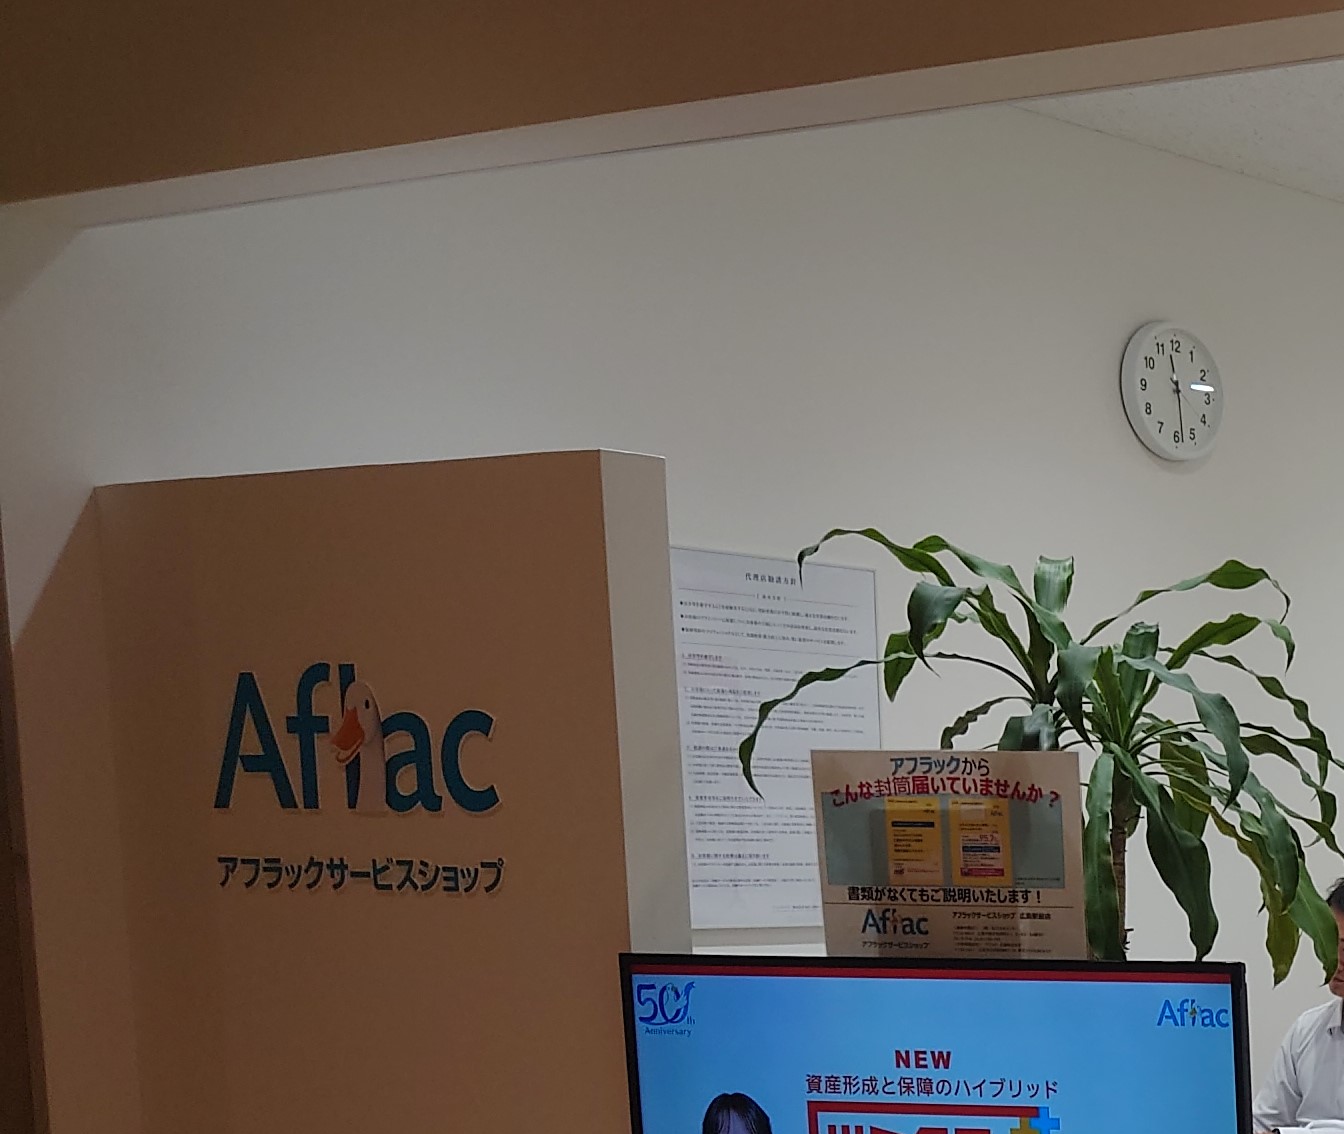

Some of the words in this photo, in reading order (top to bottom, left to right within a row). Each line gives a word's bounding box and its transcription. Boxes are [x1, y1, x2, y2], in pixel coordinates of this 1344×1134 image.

[1156, 342, 1165, 355] 11
[1170, 339, 1181, 353] 12
[1144, 356, 1155, 370] 10
[1189, 350, 1195, 363] 1
[1200, 369, 1207, 382] 2
[1140, 378, 1147, 391] 9
[1204, 393, 1211, 405] 3
[1145, 402, 1152, 415] 8
[1200, 414, 1207, 426] 4
[1157, 421, 1164, 433] 7
[1173, 431, 1180, 443] 6
[1189, 428, 1196, 441] 5
[213, 662, 502, 814] Aflac
[889, 756, 990, 776] アフラックから
[215, 853, 506, 896] アフラックサービスショップ
[861, 908, 929, 936] Aflac
[1156, 998, 1230, 1028] Aflac
[894, 1049, 952, 1069] NEW
[805, 1074, 1059, 1100] 資産形成と保障のハイブリッド
